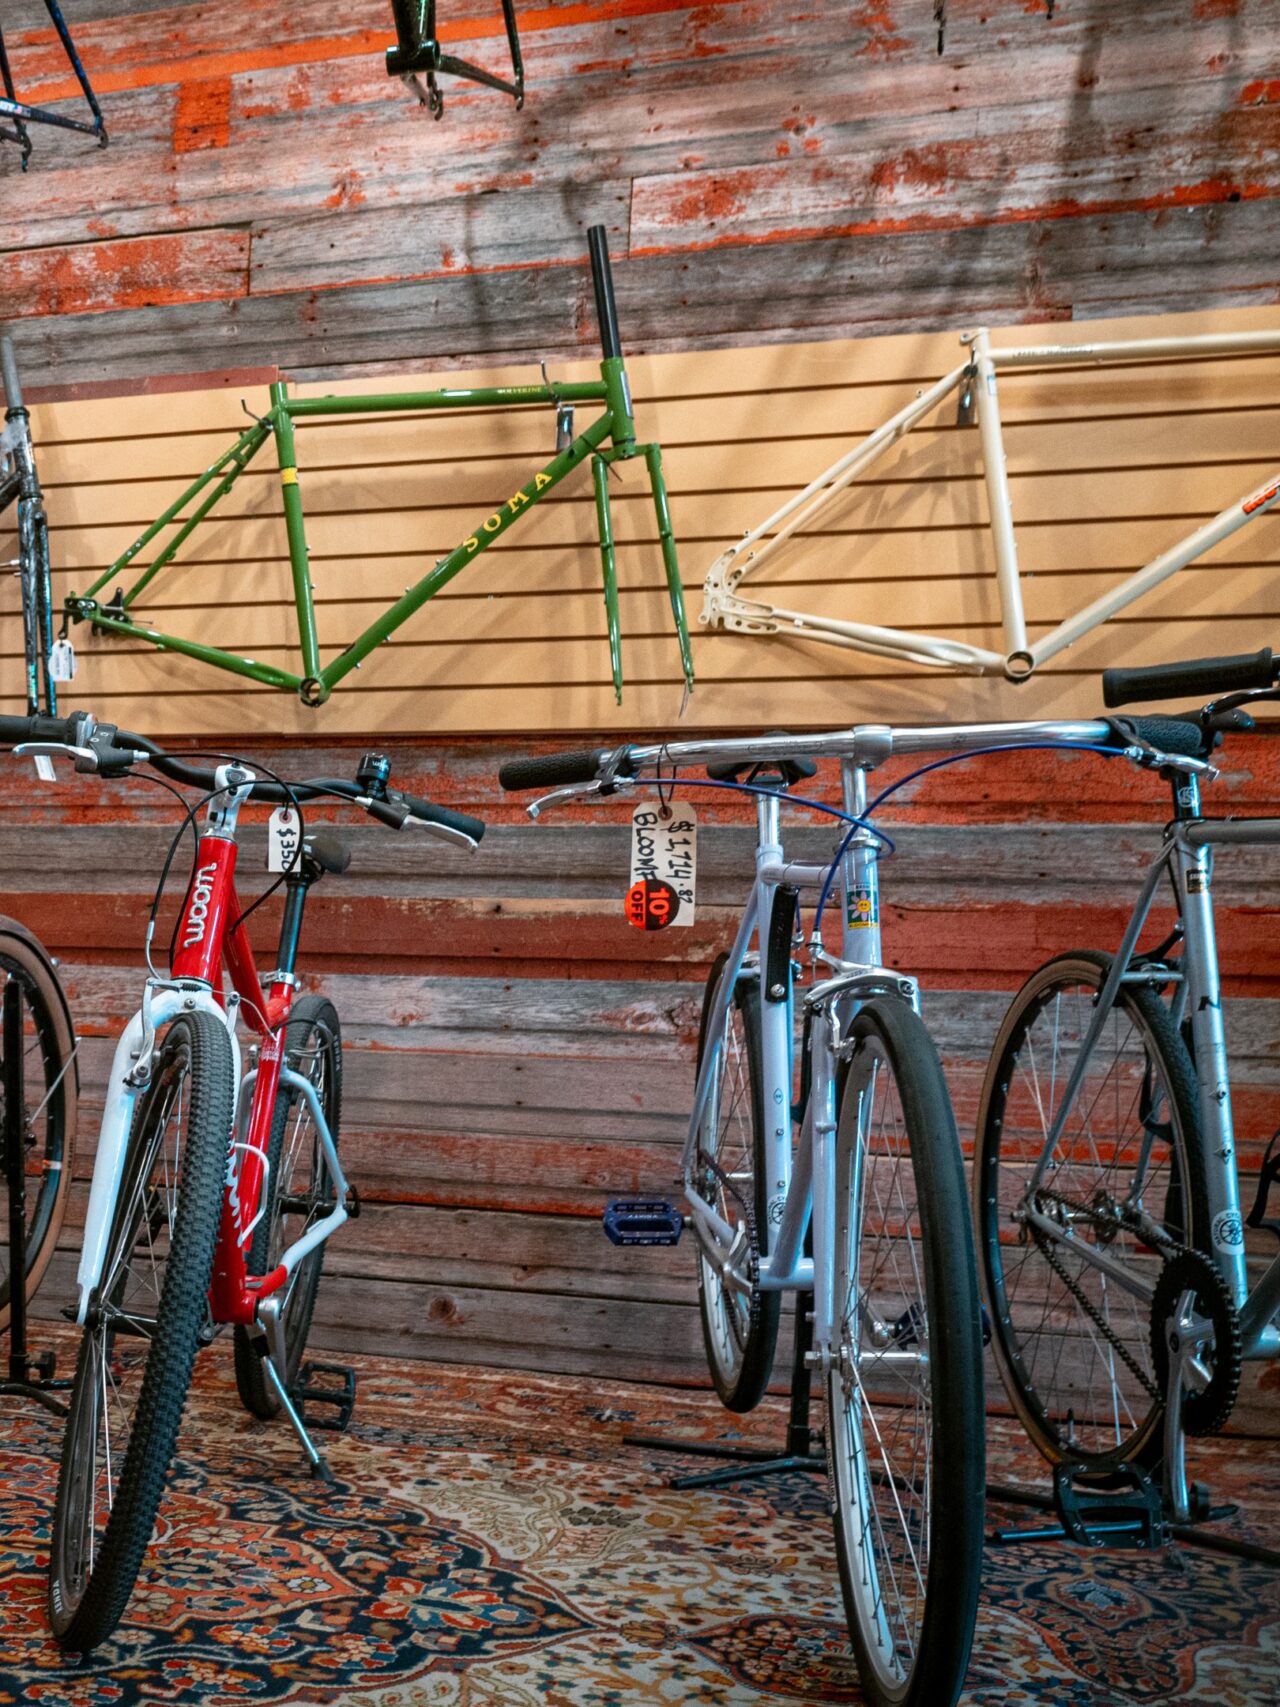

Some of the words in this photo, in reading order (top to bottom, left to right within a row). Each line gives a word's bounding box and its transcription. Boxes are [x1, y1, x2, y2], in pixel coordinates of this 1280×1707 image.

[497, 386, 543, 395] WOLVERINE
[463, 472, 553, 553] SOMA
[276, 827, 297, 872] $350
[183, 862, 218, 949] woom
[631, 890, 645, 922] OFF
